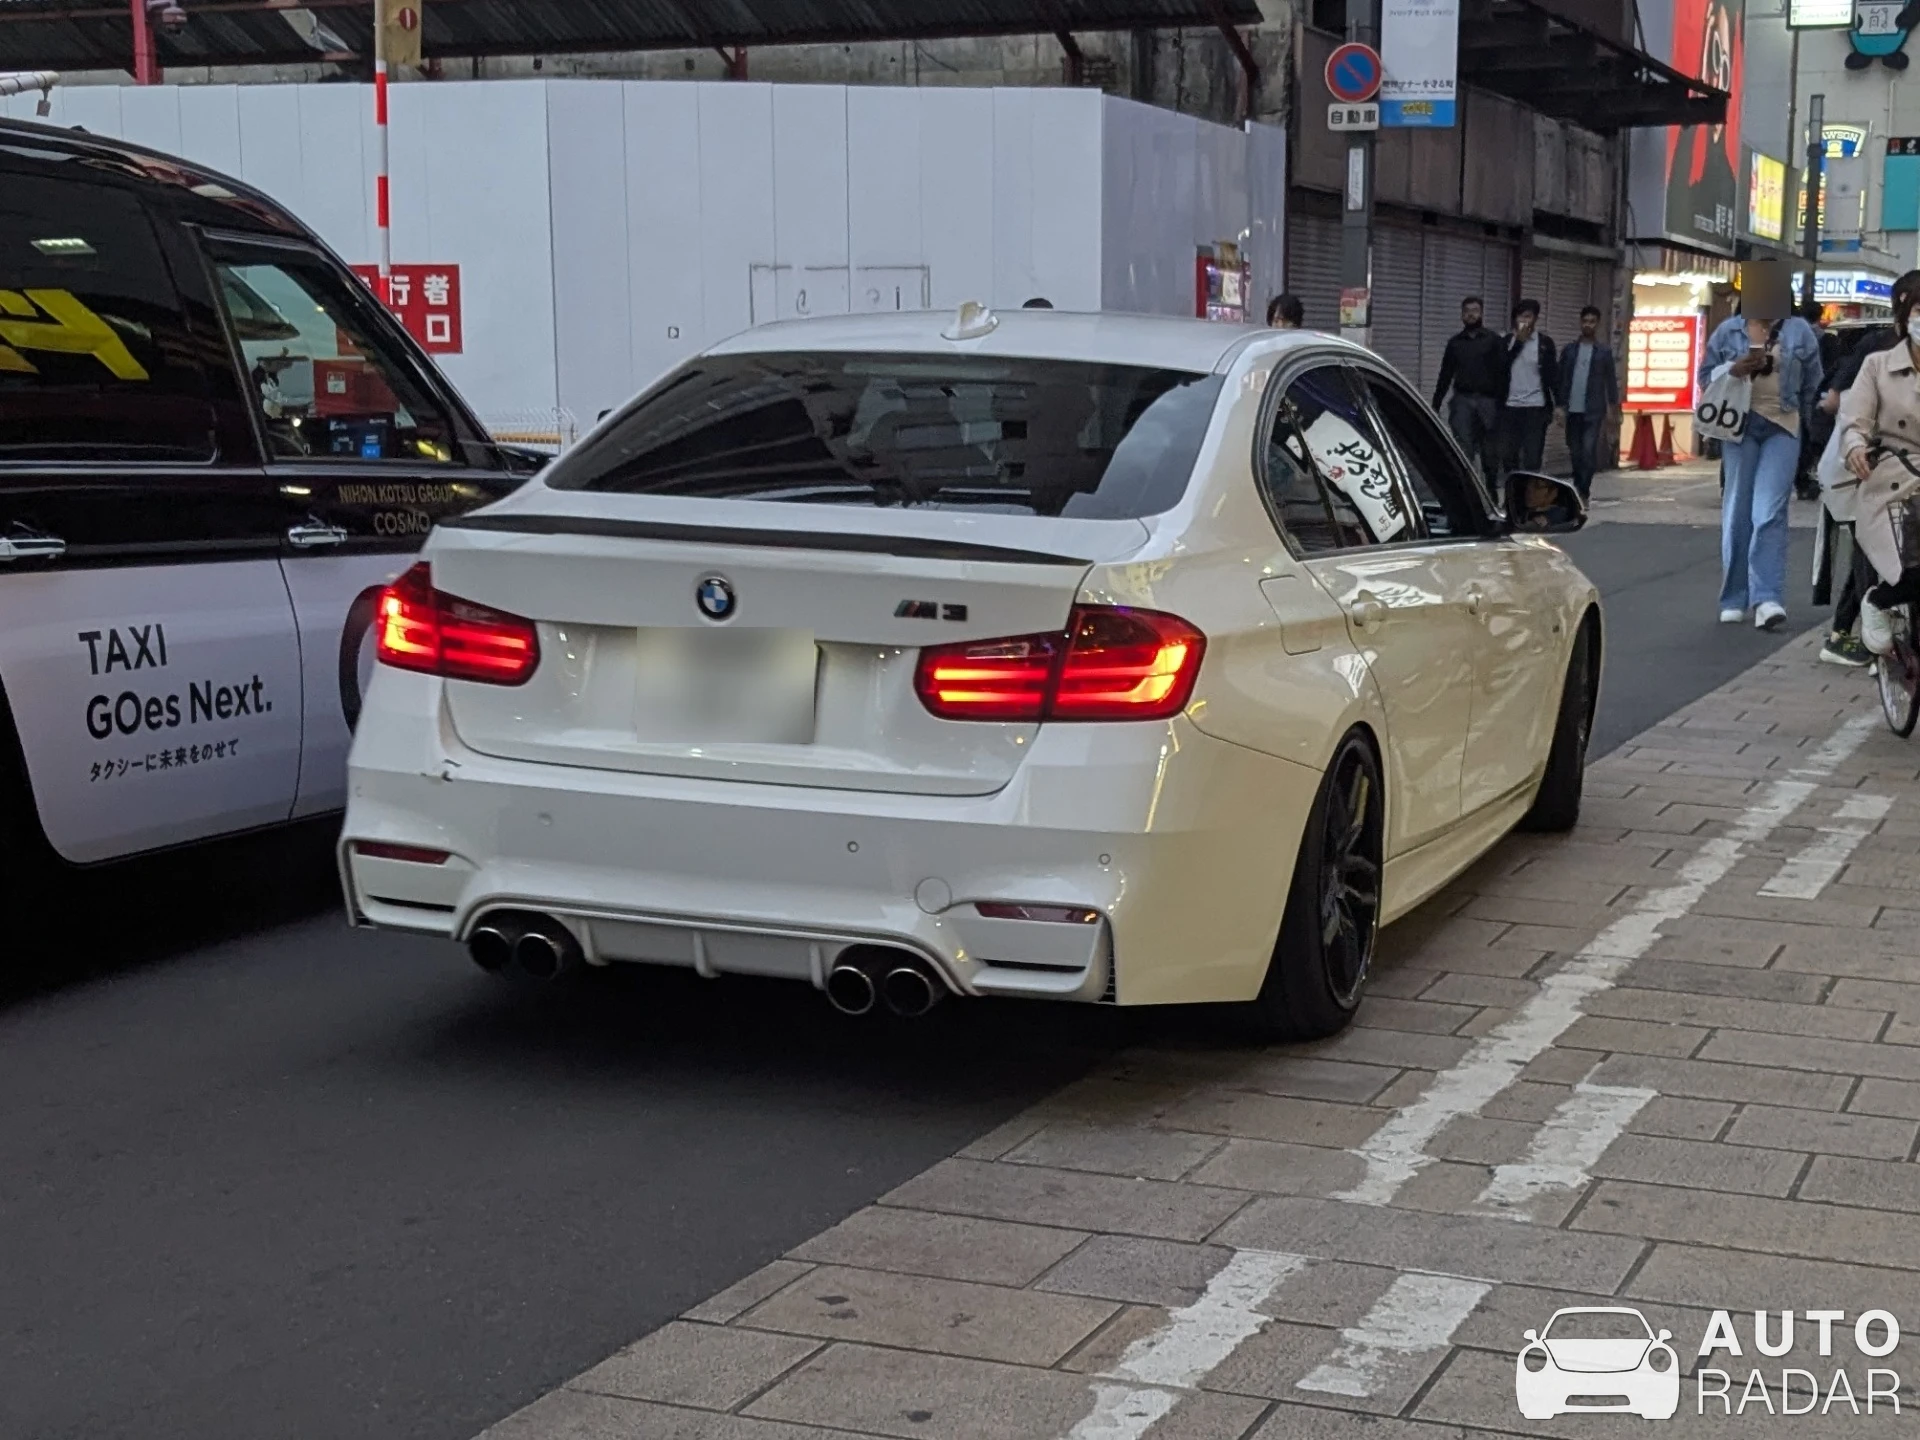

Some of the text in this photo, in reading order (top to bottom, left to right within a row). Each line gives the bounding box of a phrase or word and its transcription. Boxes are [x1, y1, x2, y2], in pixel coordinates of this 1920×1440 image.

[1330, 110, 1377, 124] 自動車
[1821, 130, 1858, 143] AWSON
[358, 274, 450, 306] 行者
[338, 484, 378, 504] NIHON
[380, 484, 416, 504] KOTSU
[374, 510, 431, 535] COSMO
[893, 599, 968, 622] M3
[78, 623, 168, 675] TAXI
[86, 674, 273, 740] GOes Next.
[90, 738, 239, 782] タクシーに未来をのせて
